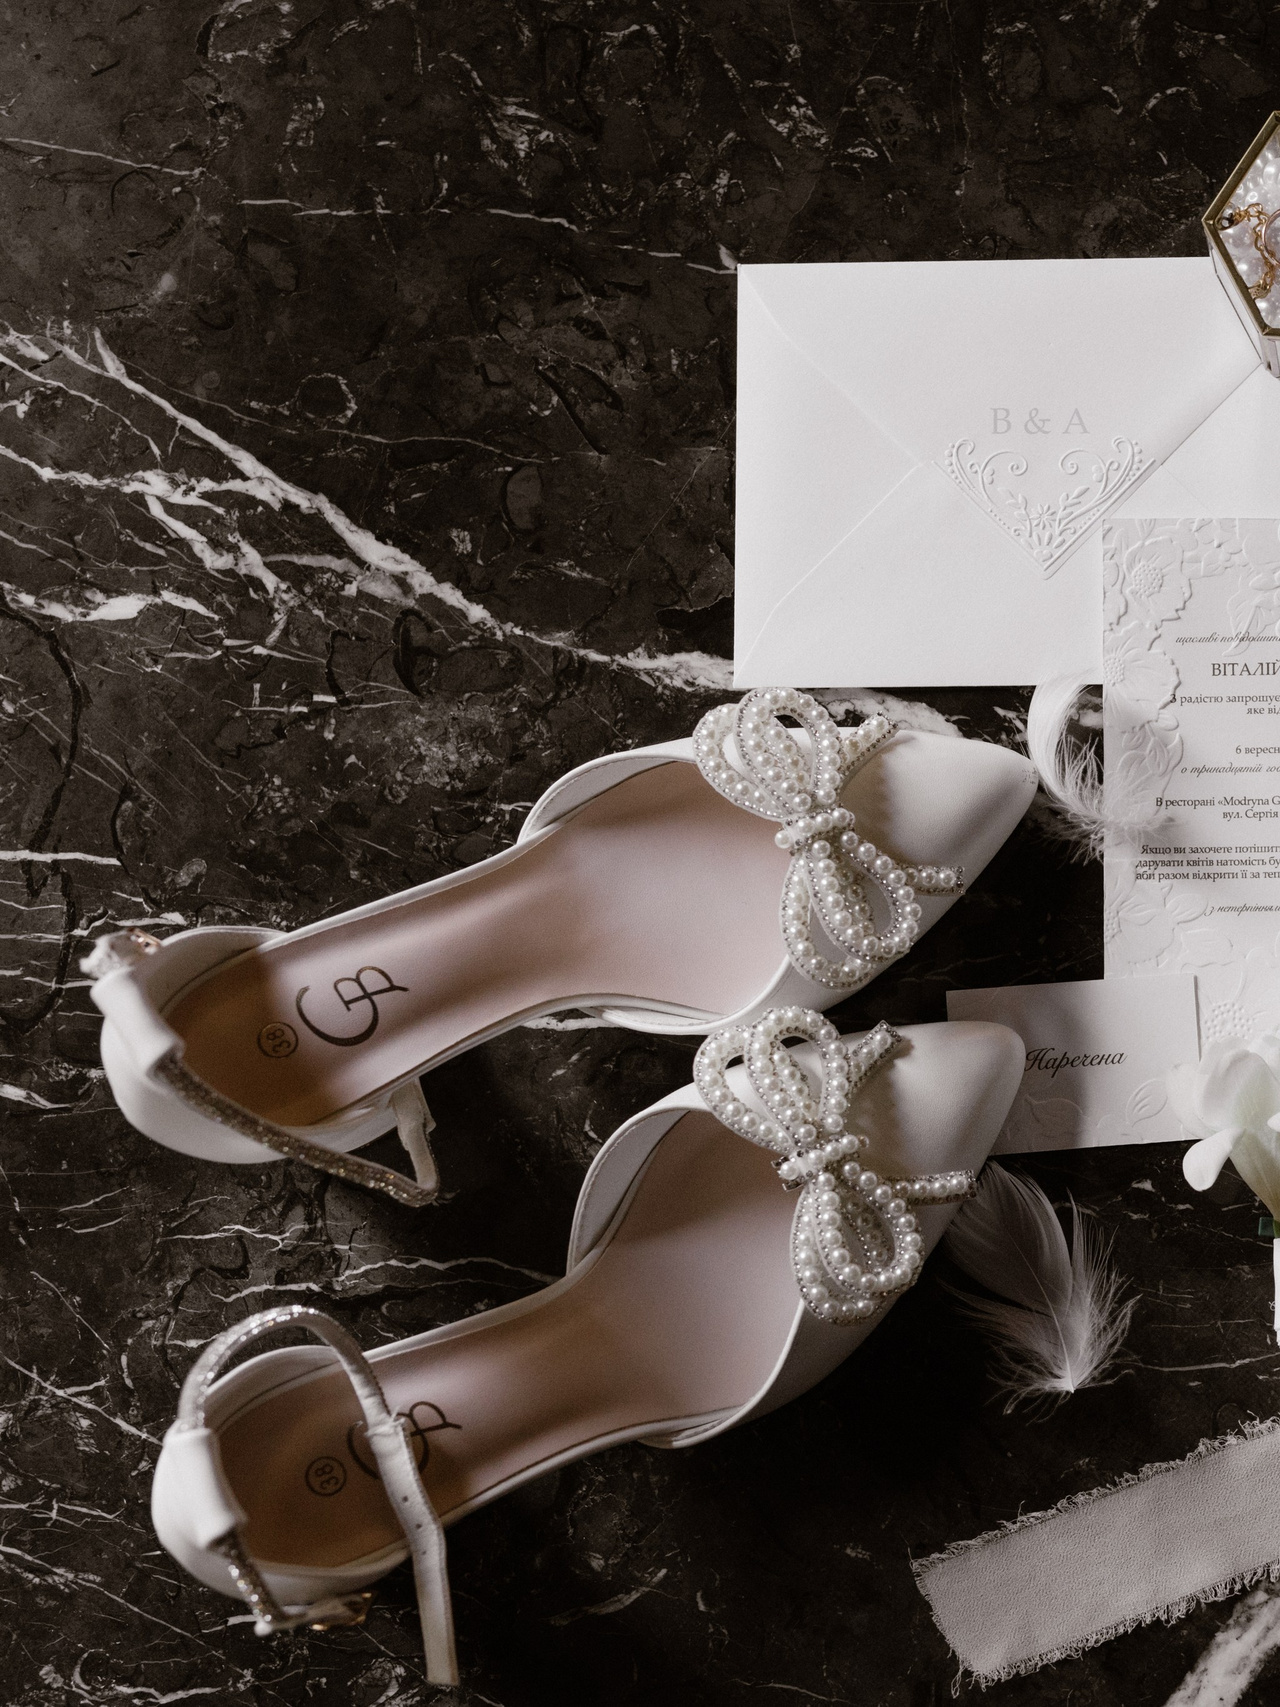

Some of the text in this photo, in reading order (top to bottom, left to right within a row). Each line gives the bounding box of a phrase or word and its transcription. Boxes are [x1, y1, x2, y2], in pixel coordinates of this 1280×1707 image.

[1024, 408, 1051, 434] &
[1062, 408, 1090, 434] A
[1180, 693, 1223, 706] радістю
[1235, 745, 1242, 754] 6
[1156, 797, 1163, 806] В
[1165, 797, 1215, 809] ресторані
[1223, 811, 1242, 821] вул.
[1245, 809, 1278, 821] Сергія
[1141, 845, 1171, 855] Якщо
[1189, 846, 1232, 854] захочете
[1136, 860, 1184, 870] дарувати
[1187, 857, 1214, 867] квітів
[1216, 857, 1267, 867] натомість
[1136, 870, 1155, 880] аби
[1159, 872, 1189, 882] разом
[1192, 870, 1238, 882] відкрити
[1240, 869, 1248, 879] її
[1024, 1047, 1127, 1078] Наречена
[315, 1463, 339, 1490] 38
